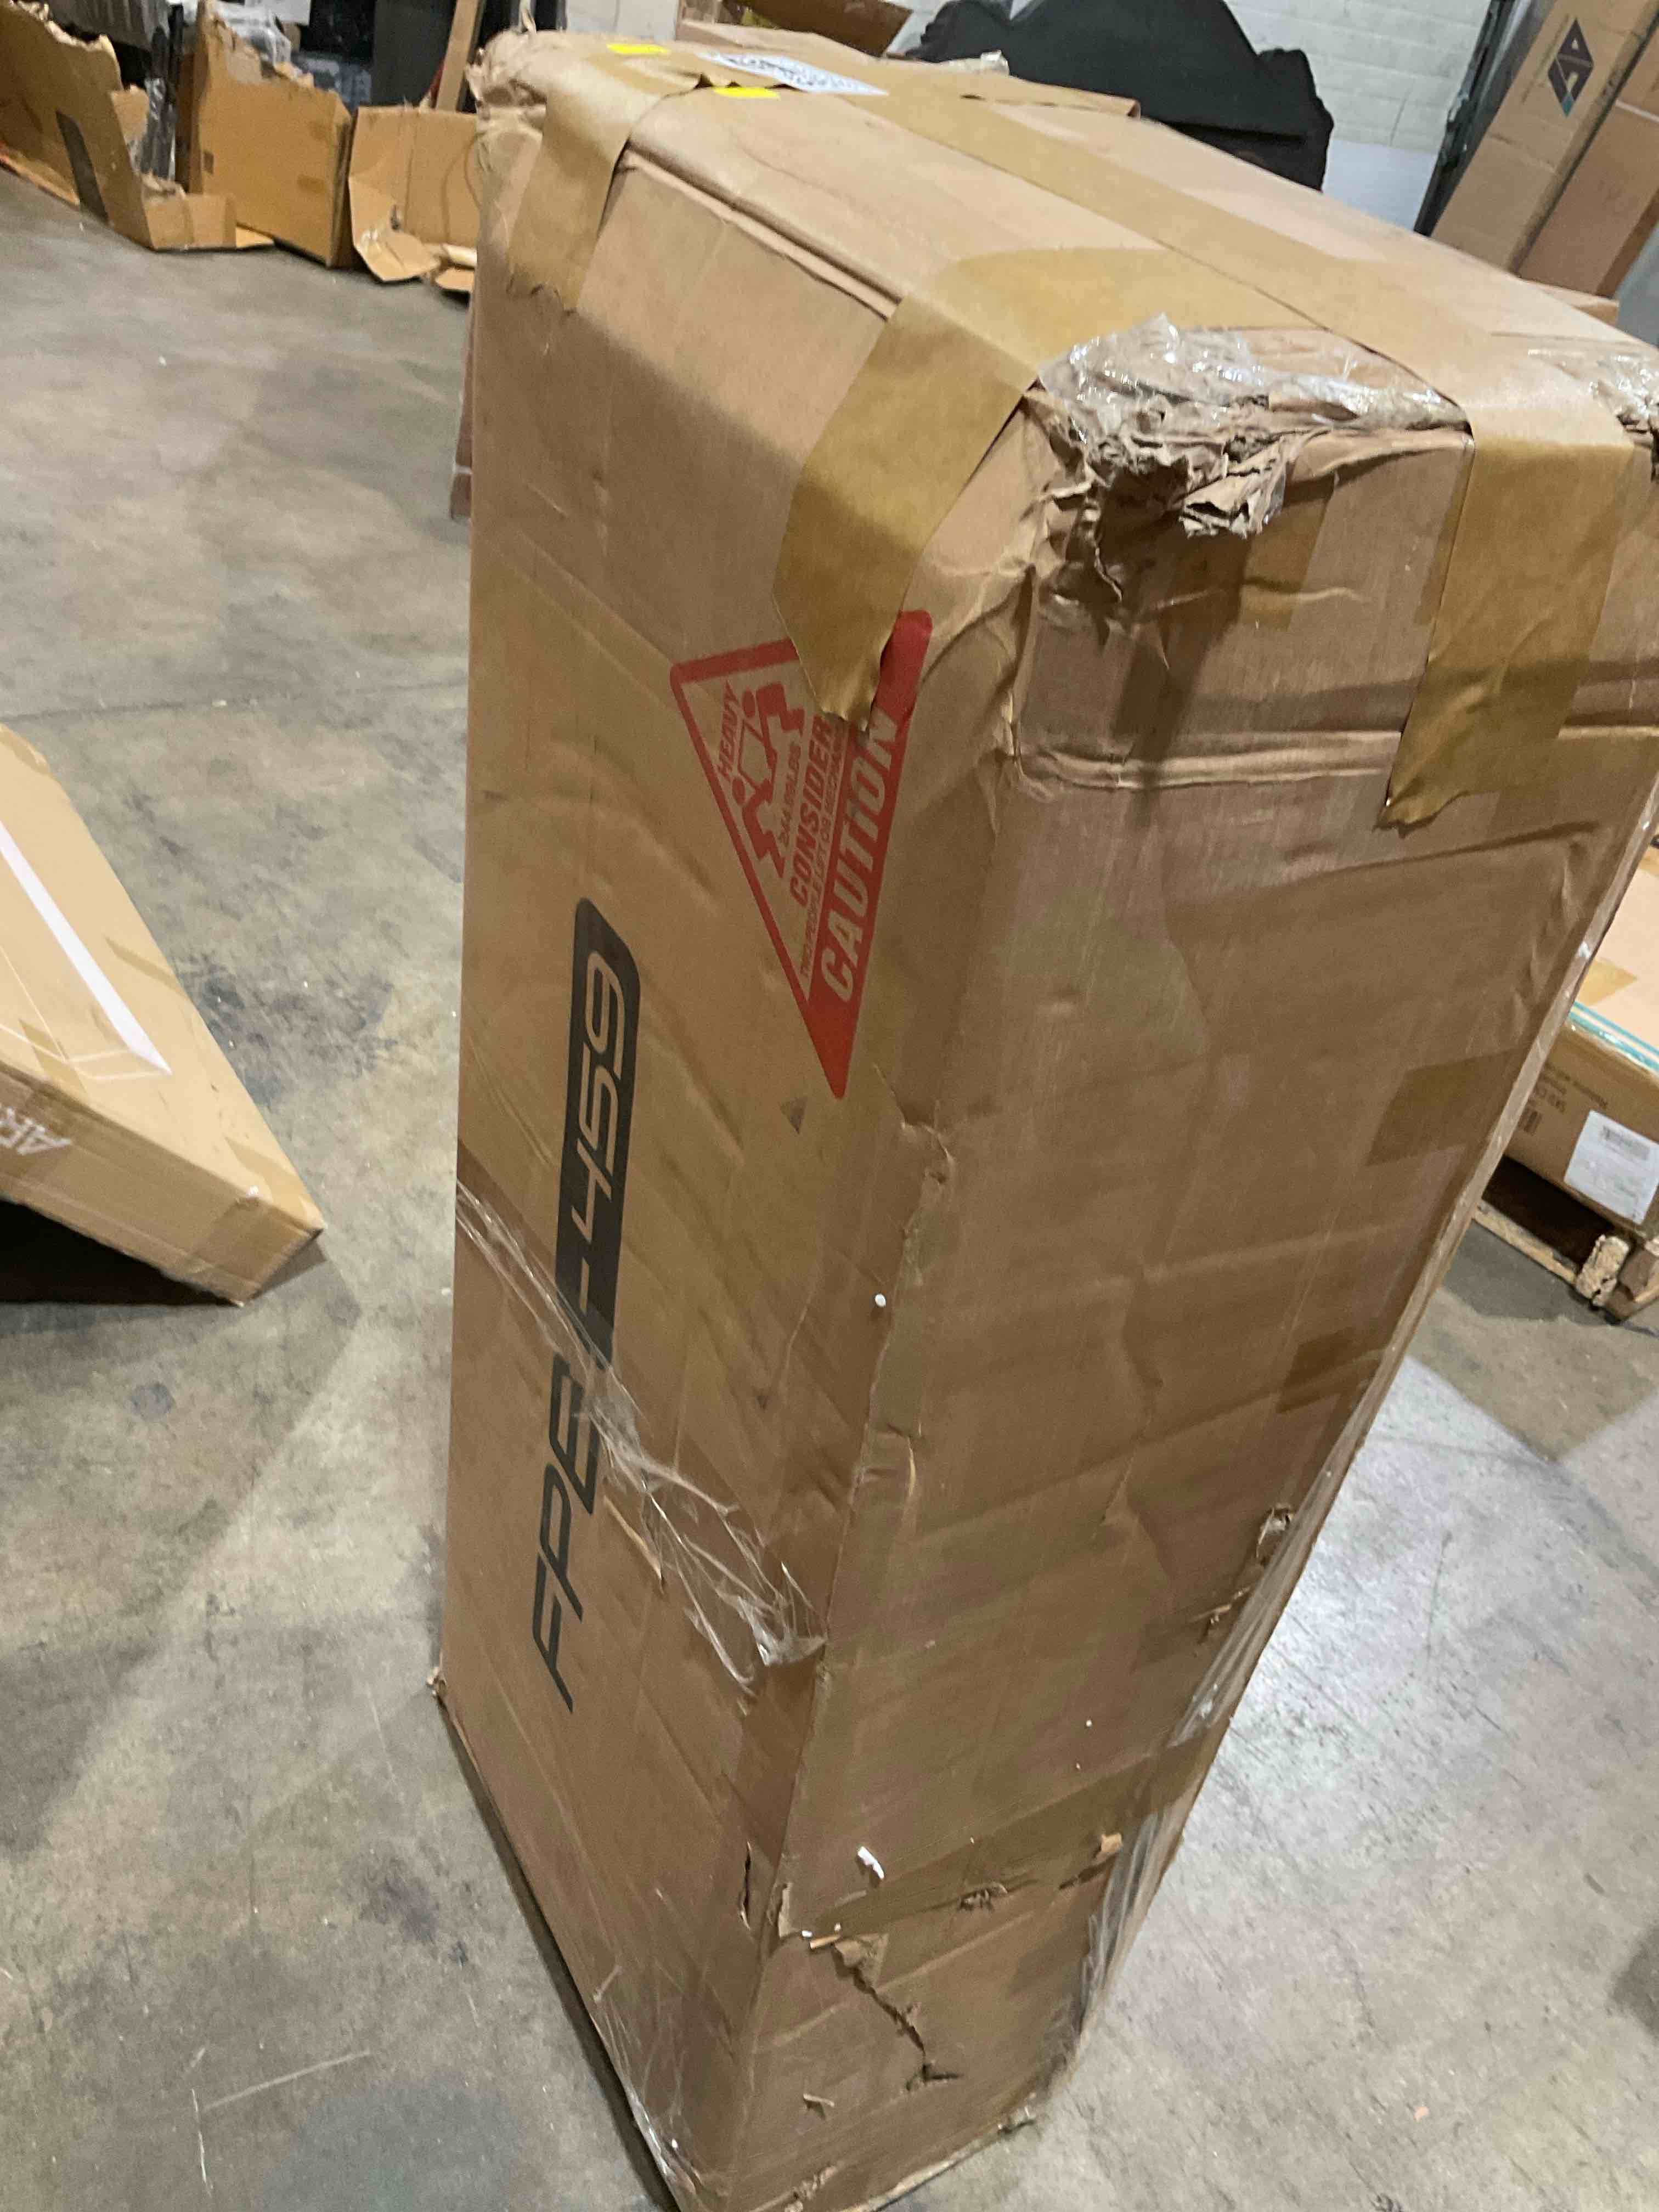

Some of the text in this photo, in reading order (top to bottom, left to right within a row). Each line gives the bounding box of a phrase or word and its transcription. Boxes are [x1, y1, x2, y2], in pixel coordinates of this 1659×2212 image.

[714, 680, 740, 782] HEAVY
[789, 714, 838, 907] CONSIDER
[805, 881, 823, 943] PEOPLE
[820, 817, 832, 843] OR
[820, 706, 898, 1002] CAUTION
